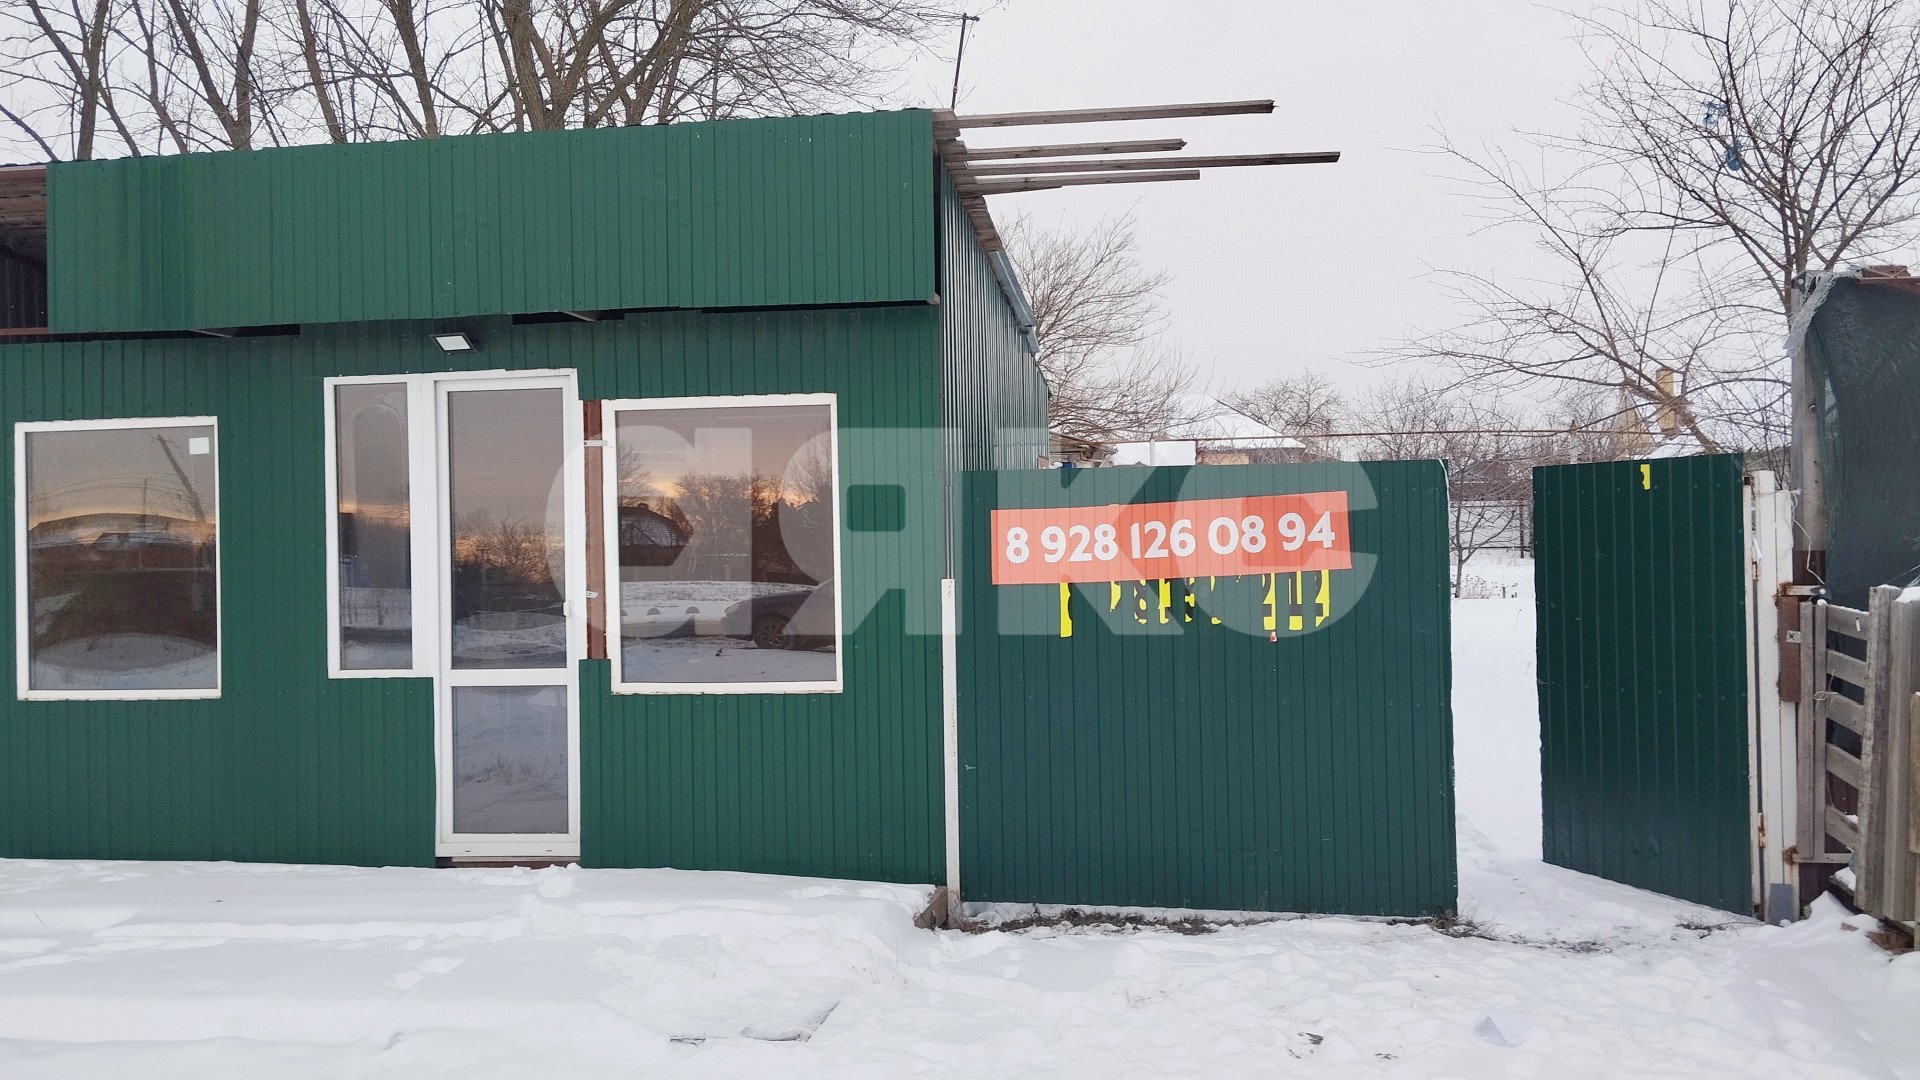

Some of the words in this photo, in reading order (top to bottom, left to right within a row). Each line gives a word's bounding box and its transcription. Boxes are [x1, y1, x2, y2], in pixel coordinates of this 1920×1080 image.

[1005, 526, 1030, 564] 8
[1040, 522, 1119, 564] 928
[1131, 518, 1197, 560] 126
[1207, 514, 1267, 556] 08
[1277, 510, 1336, 553] 94
